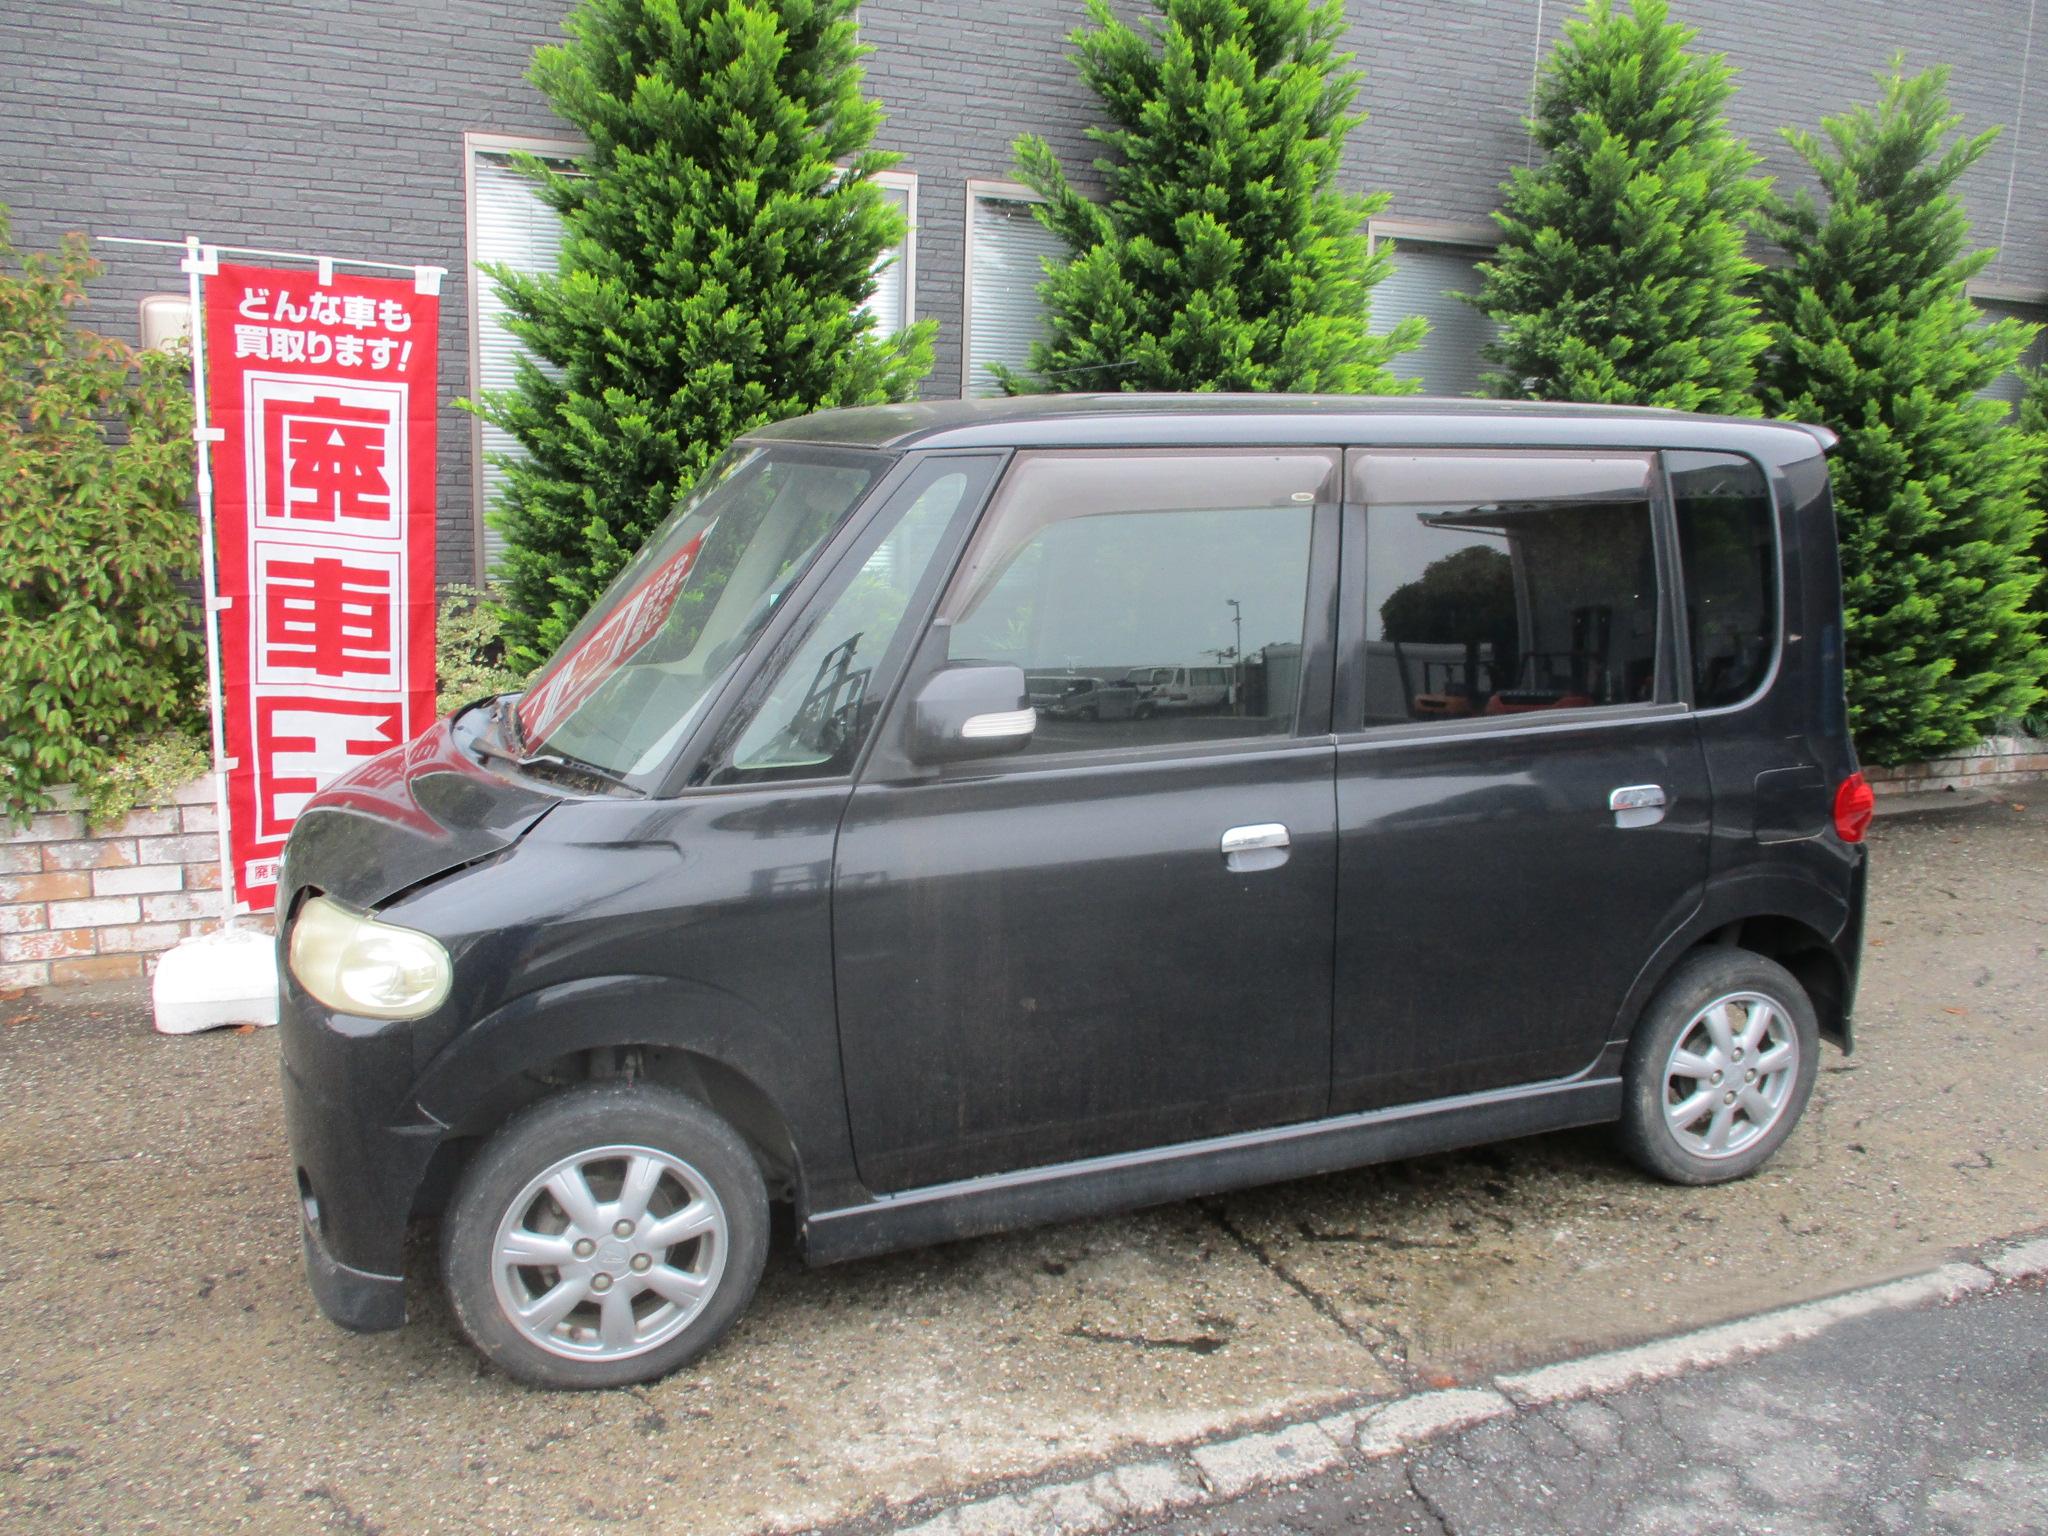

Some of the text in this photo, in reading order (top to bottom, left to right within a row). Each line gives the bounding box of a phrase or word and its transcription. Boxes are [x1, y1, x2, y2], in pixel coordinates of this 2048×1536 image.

[238, 287, 412, 332] どんな車も
[234, 324, 413, 372] 買取ります!
